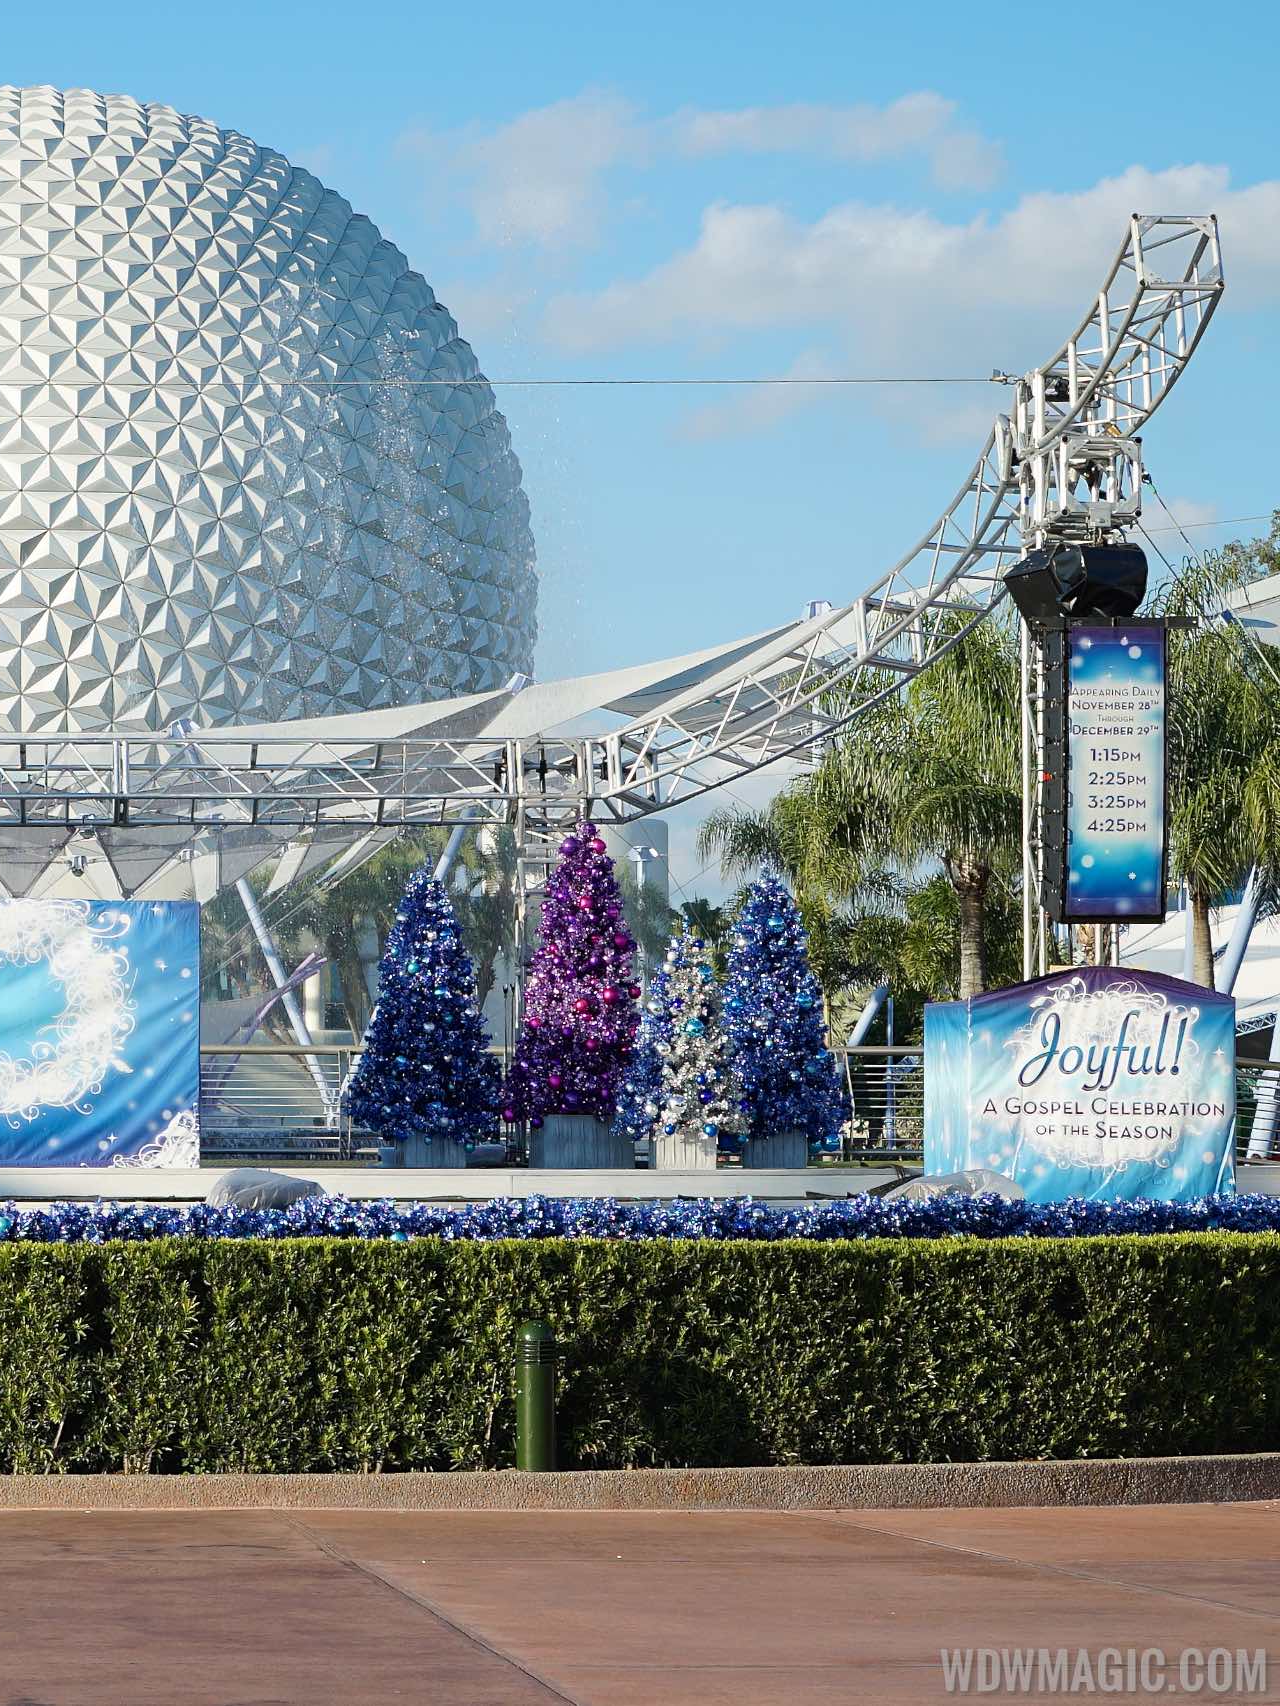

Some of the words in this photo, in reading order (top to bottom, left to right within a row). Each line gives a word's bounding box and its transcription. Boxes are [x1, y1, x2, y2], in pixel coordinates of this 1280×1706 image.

[1071, 687, 1129, 697] APPEARING
[1132, 686, 1161, 697] DAILY
[1072, 700, 1134, 711] NOVEMBER
[1072, 725, 1133, 736] DECEMBER
[1090, 748, 1141, 761] 1:15PM
[1088, 772, 1147, 785] 2:25PM
[1088, 795, 1147, 808] 3:25PM
[1087, 819, 1147, 832] 4:25PM
[1018, 1008, 1188, 1092] Joyful!
[983, 1098, 997, 1115] A
[1005, 1097, 1084, 1115] GOSPEL
[1091, 1097, 1225, 1116] CELEBRATION
[1095, 1120, 1173, 1139] SEASON
